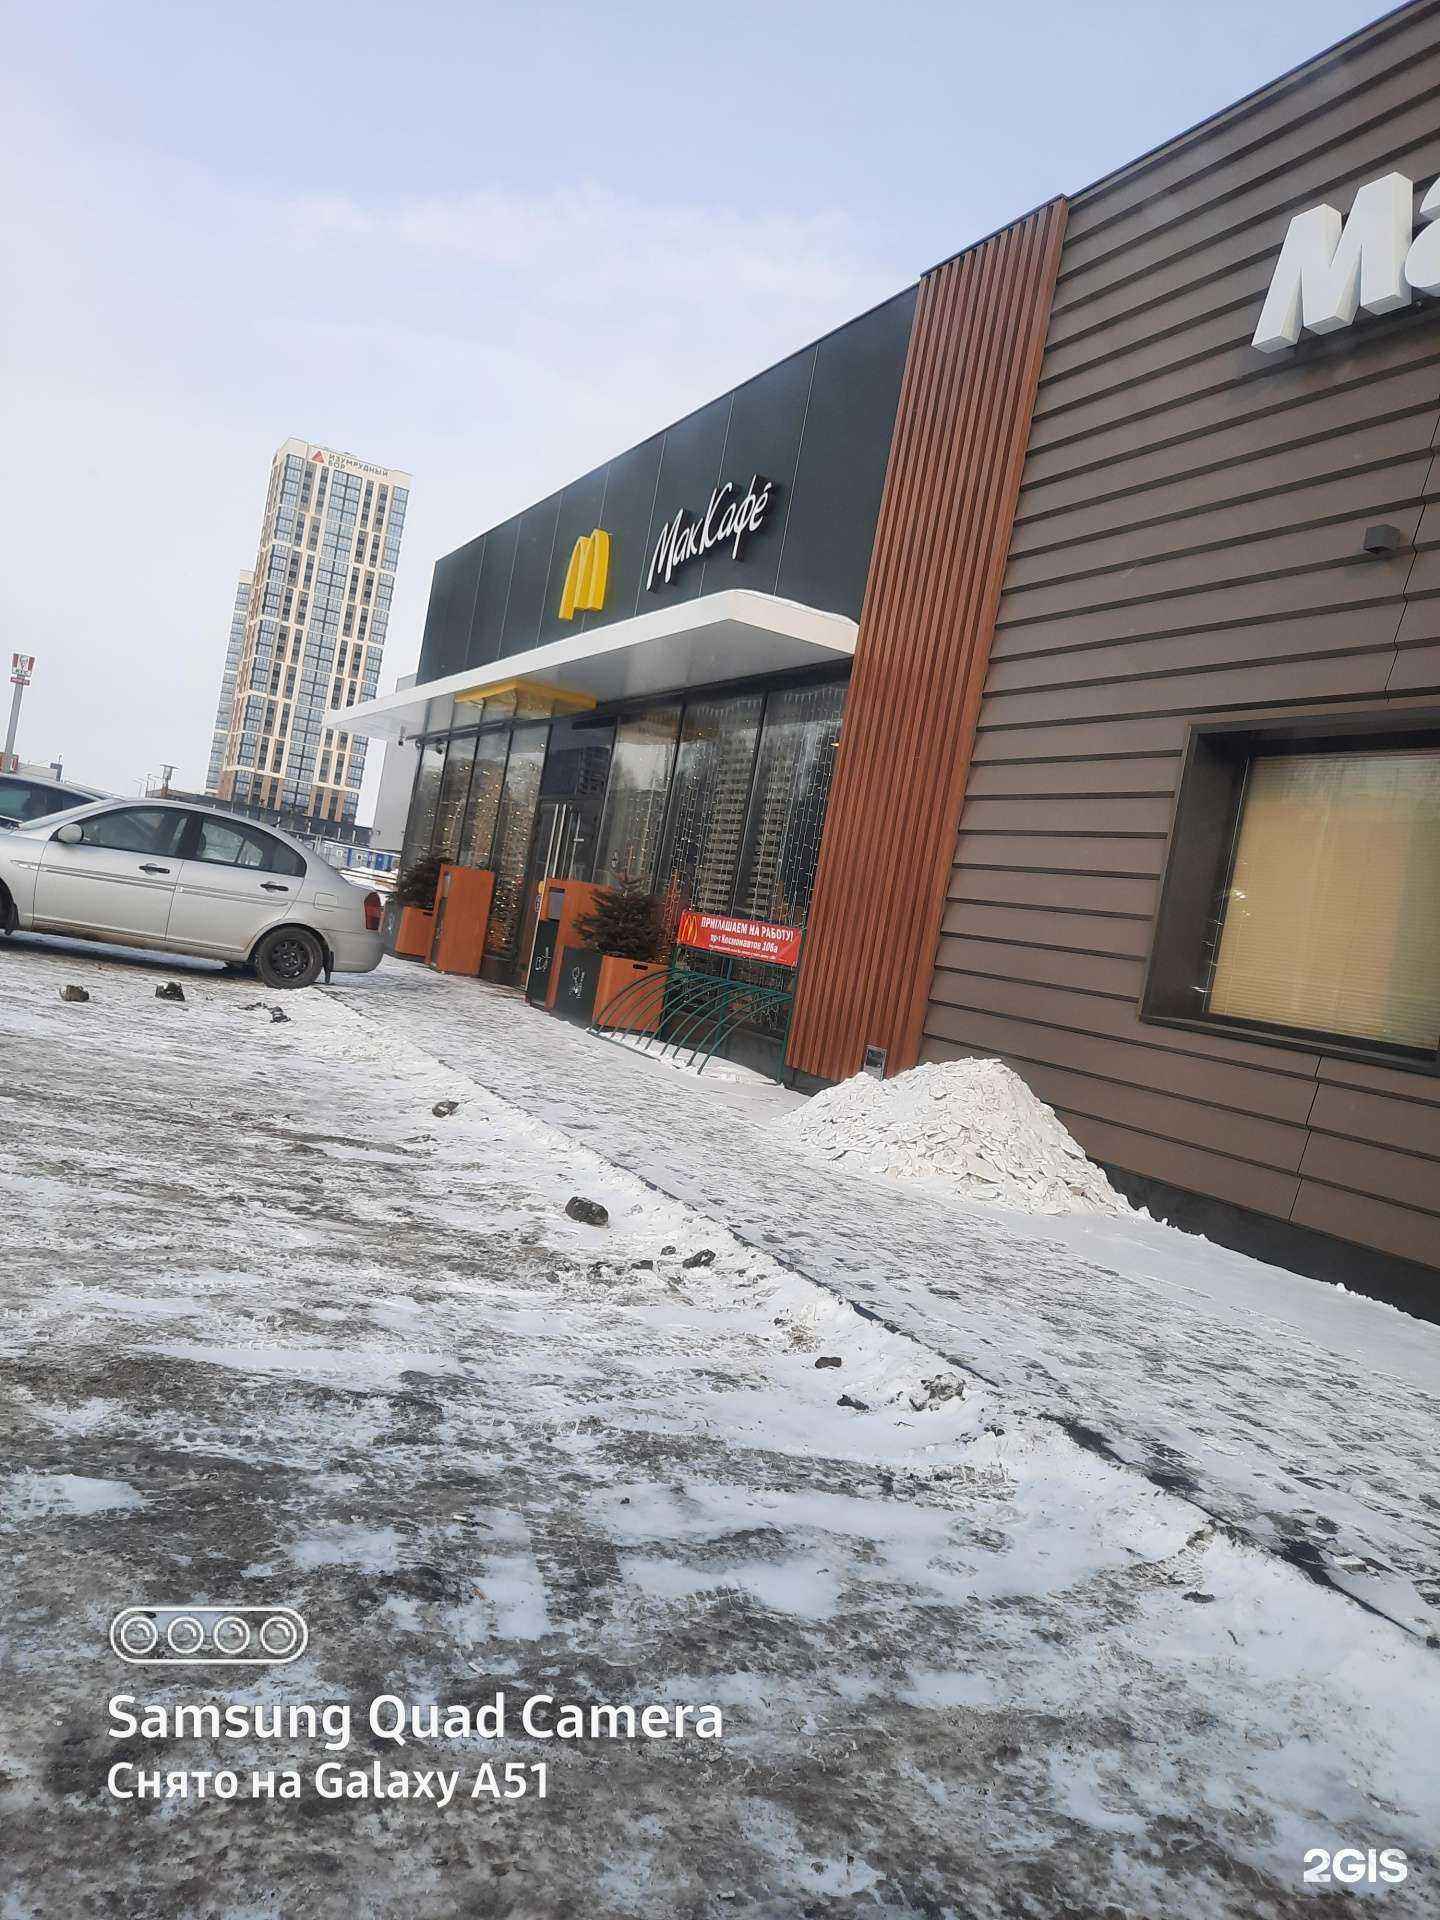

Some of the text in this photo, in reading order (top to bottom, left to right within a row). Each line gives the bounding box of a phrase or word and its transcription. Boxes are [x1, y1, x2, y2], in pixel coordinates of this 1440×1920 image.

[701, 916, 794, 942] ПРИГЛАШАЕМ НА РАБОТУ!
[721, 934, 762, 950] Космонавтов
